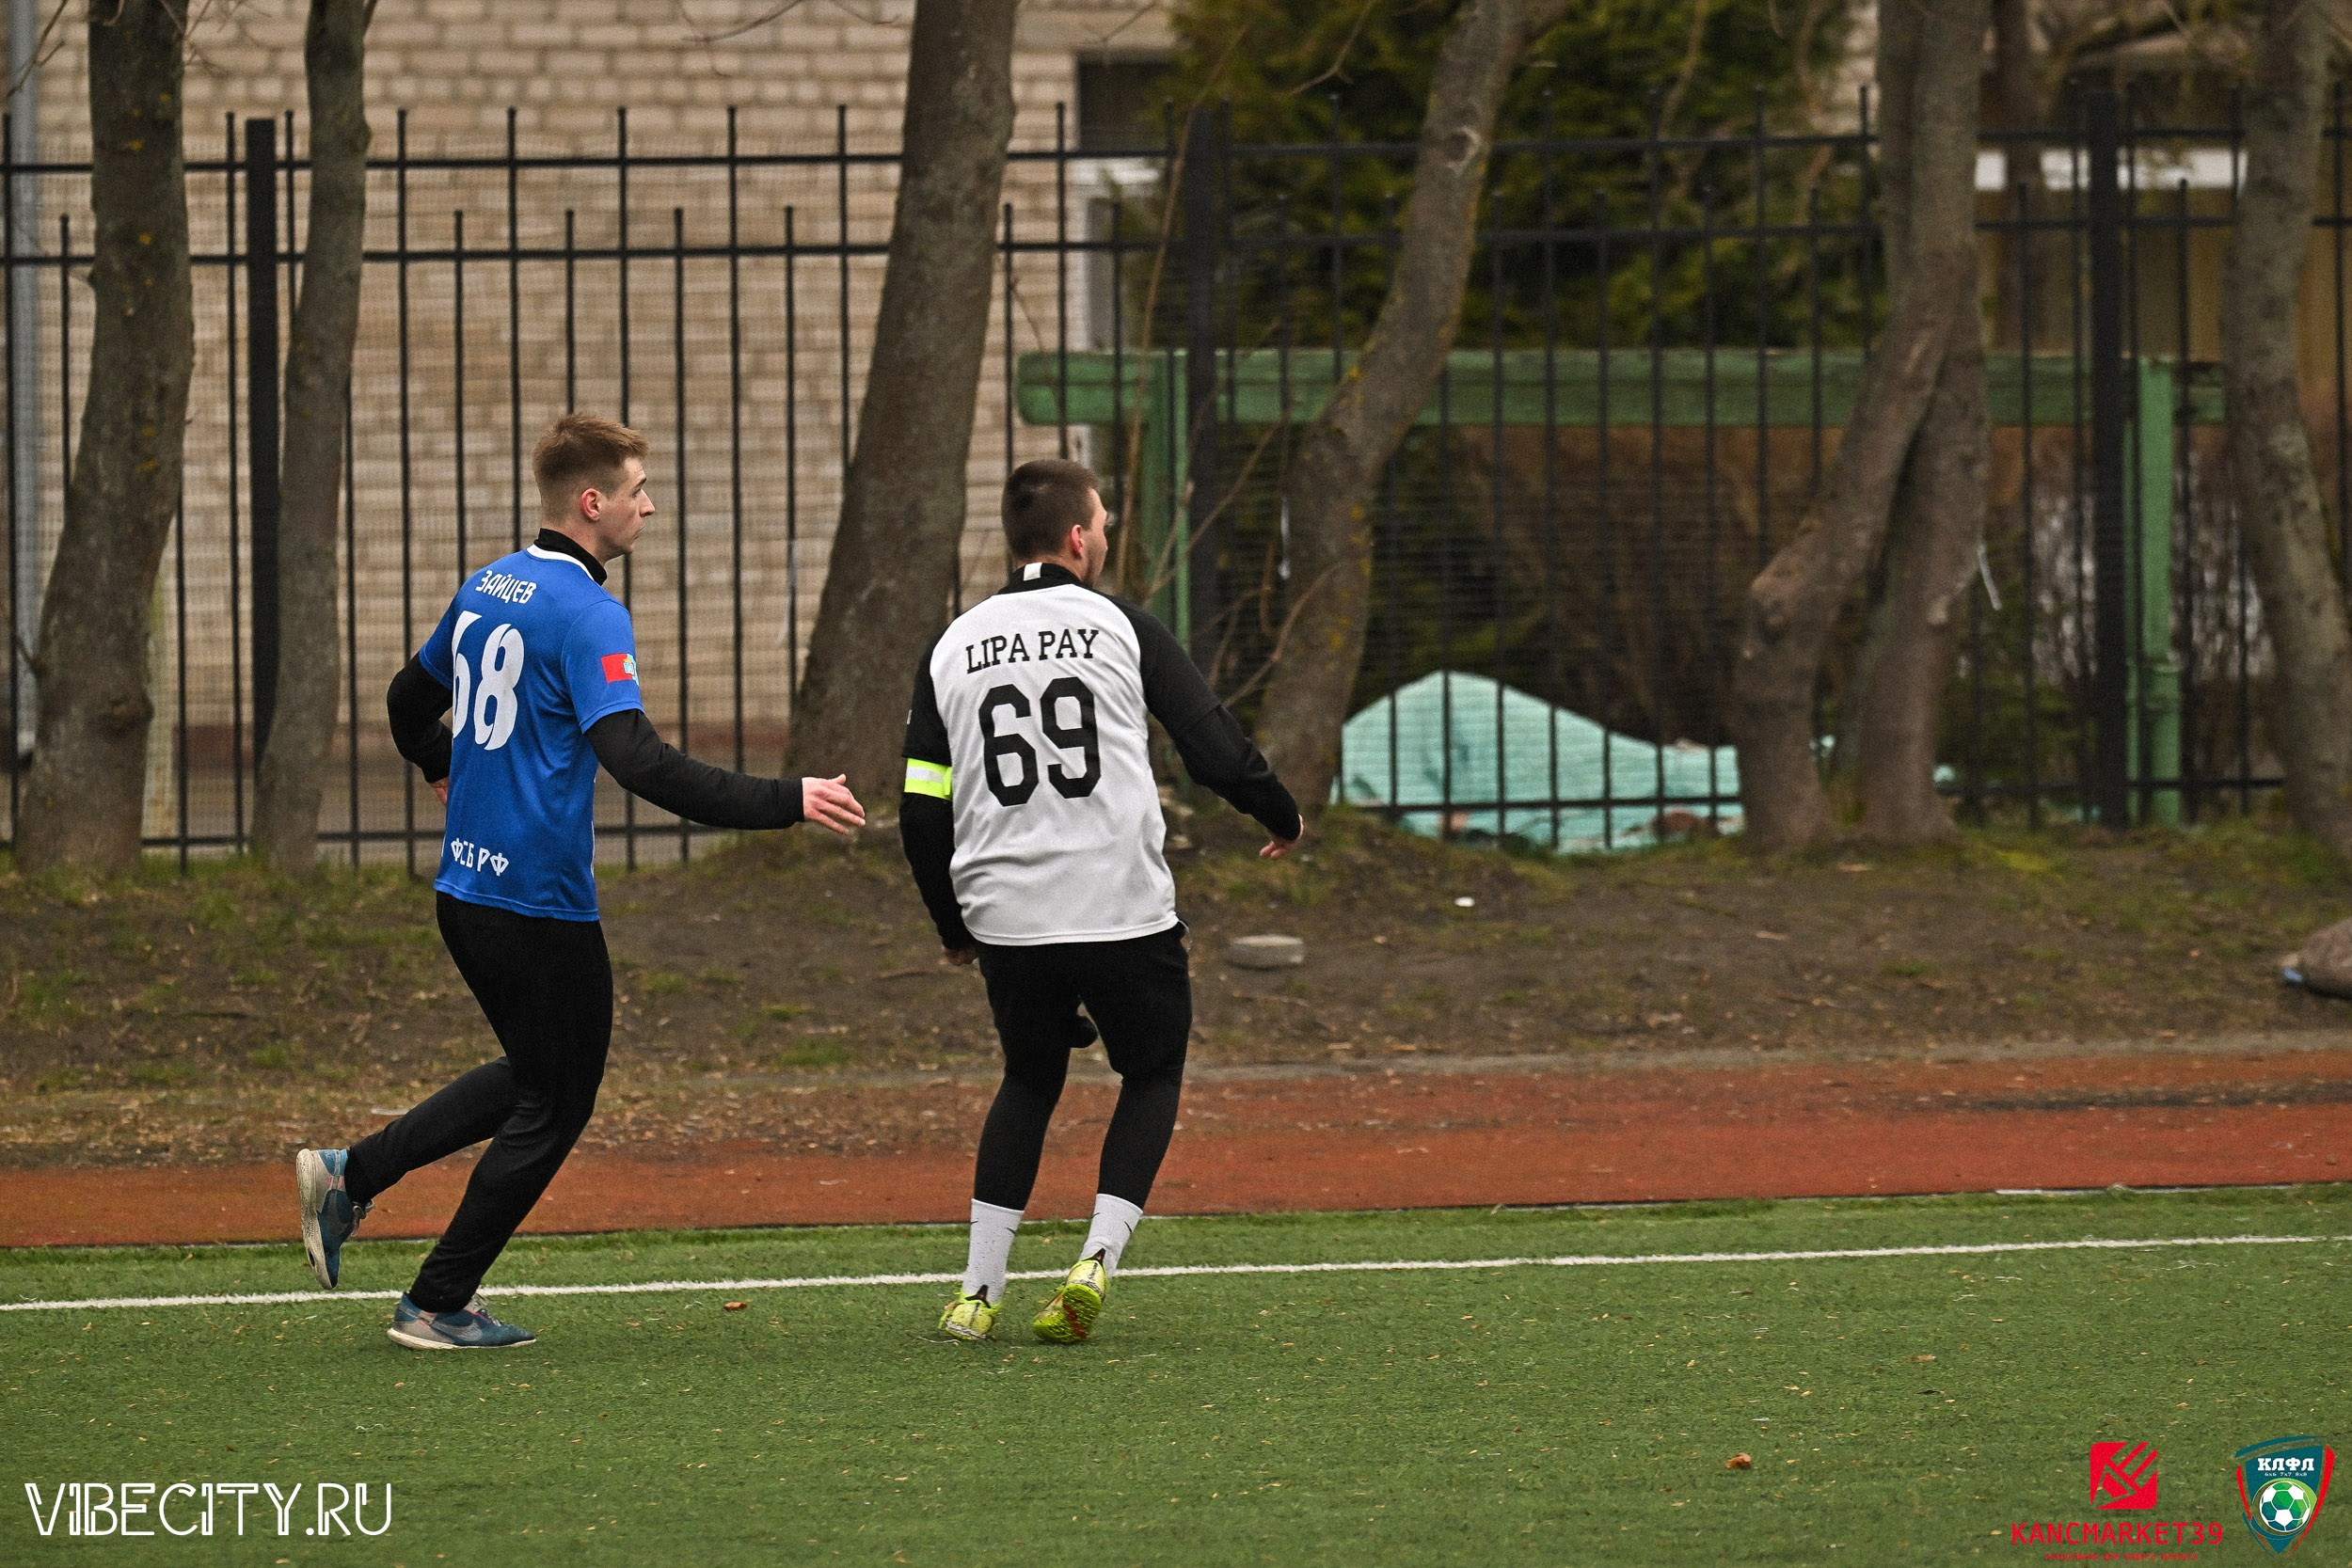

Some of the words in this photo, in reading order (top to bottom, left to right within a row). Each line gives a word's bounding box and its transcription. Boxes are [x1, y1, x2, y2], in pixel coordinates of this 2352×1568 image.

[475, 570, 537, 604] ЗАЙЦЕВ
[965, 633, 1030, 673] LIPA
[1038, 628, 1099, 660] PAY
[452, 610, 525, 751] 68
[978, 676, 1102, 807] 69
[451, 837, 474, 868] ФСБ
[477, 847, 510, 877] РФ
